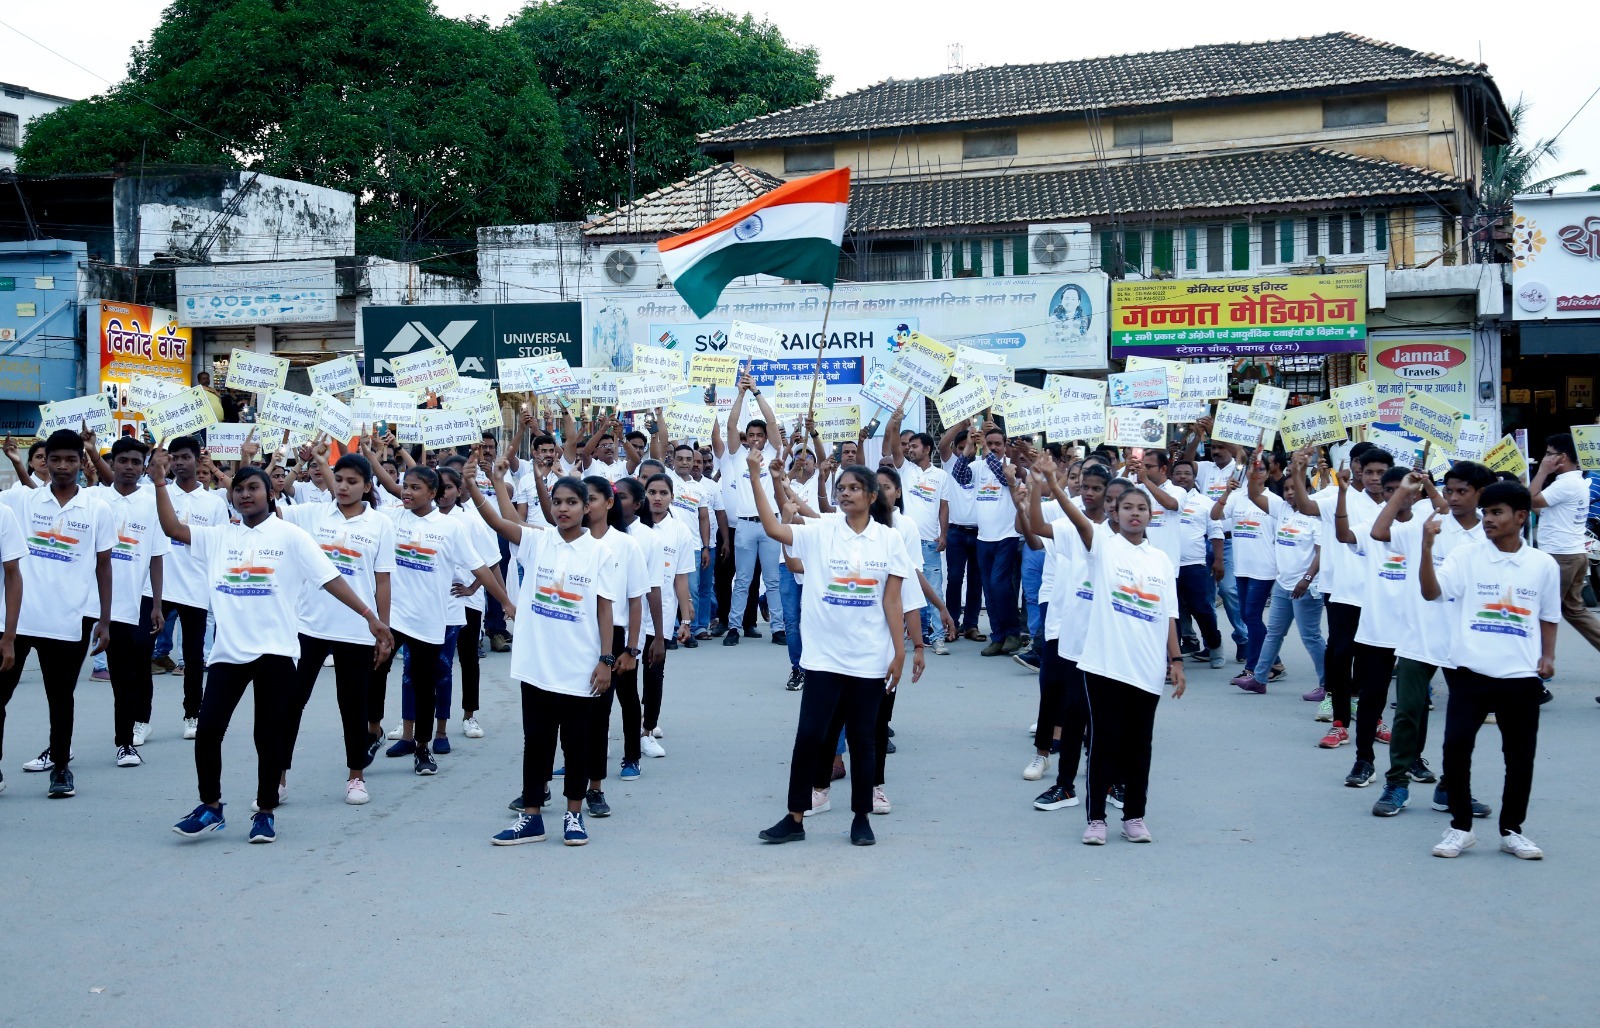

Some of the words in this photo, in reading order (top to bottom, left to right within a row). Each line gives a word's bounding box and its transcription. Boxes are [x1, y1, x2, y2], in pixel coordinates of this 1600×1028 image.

[1187, 284, 1225, 294] केमिस्ट
[1228, 284, 1249, 293] एण्ड
[1252, 282, 1288, 294] ड्रगिस्ट
[799, 297, 819, 312] की
[1121, 303, 1221, 328] जन्नत
[1228, 293, 1358, 324] मेडिकोज
[107, 319, 152, 360] विनोद
[158, 326, 187, 360] वॉच
[503, 333, 571, 344] UNIVERSAL
[1135, 332, 1152, 341] सभी
[1154, 333, 1176, 342] प्रकार
[1178, 331, 1186, 340] के
[1216, 330, 1229, 339] एवं
[1231, 328, 1271, 341] आयुर्वेदिक
[1306, 328, 1315, 336] के
[1316, 327, 1344, 336] विक्रेता
[518, 346, 557, 357] STORE
[1176, 345, 1203, 353] स्टेशन
[1236, 345, 1265, 353] रायगढ़
[1392, 349, 1450, 363] Jannat
[374, 357, 486, 373] NA
[1402, 368, 1440, 377] Travels
[1420, 404, 1437, 420] मतदान
